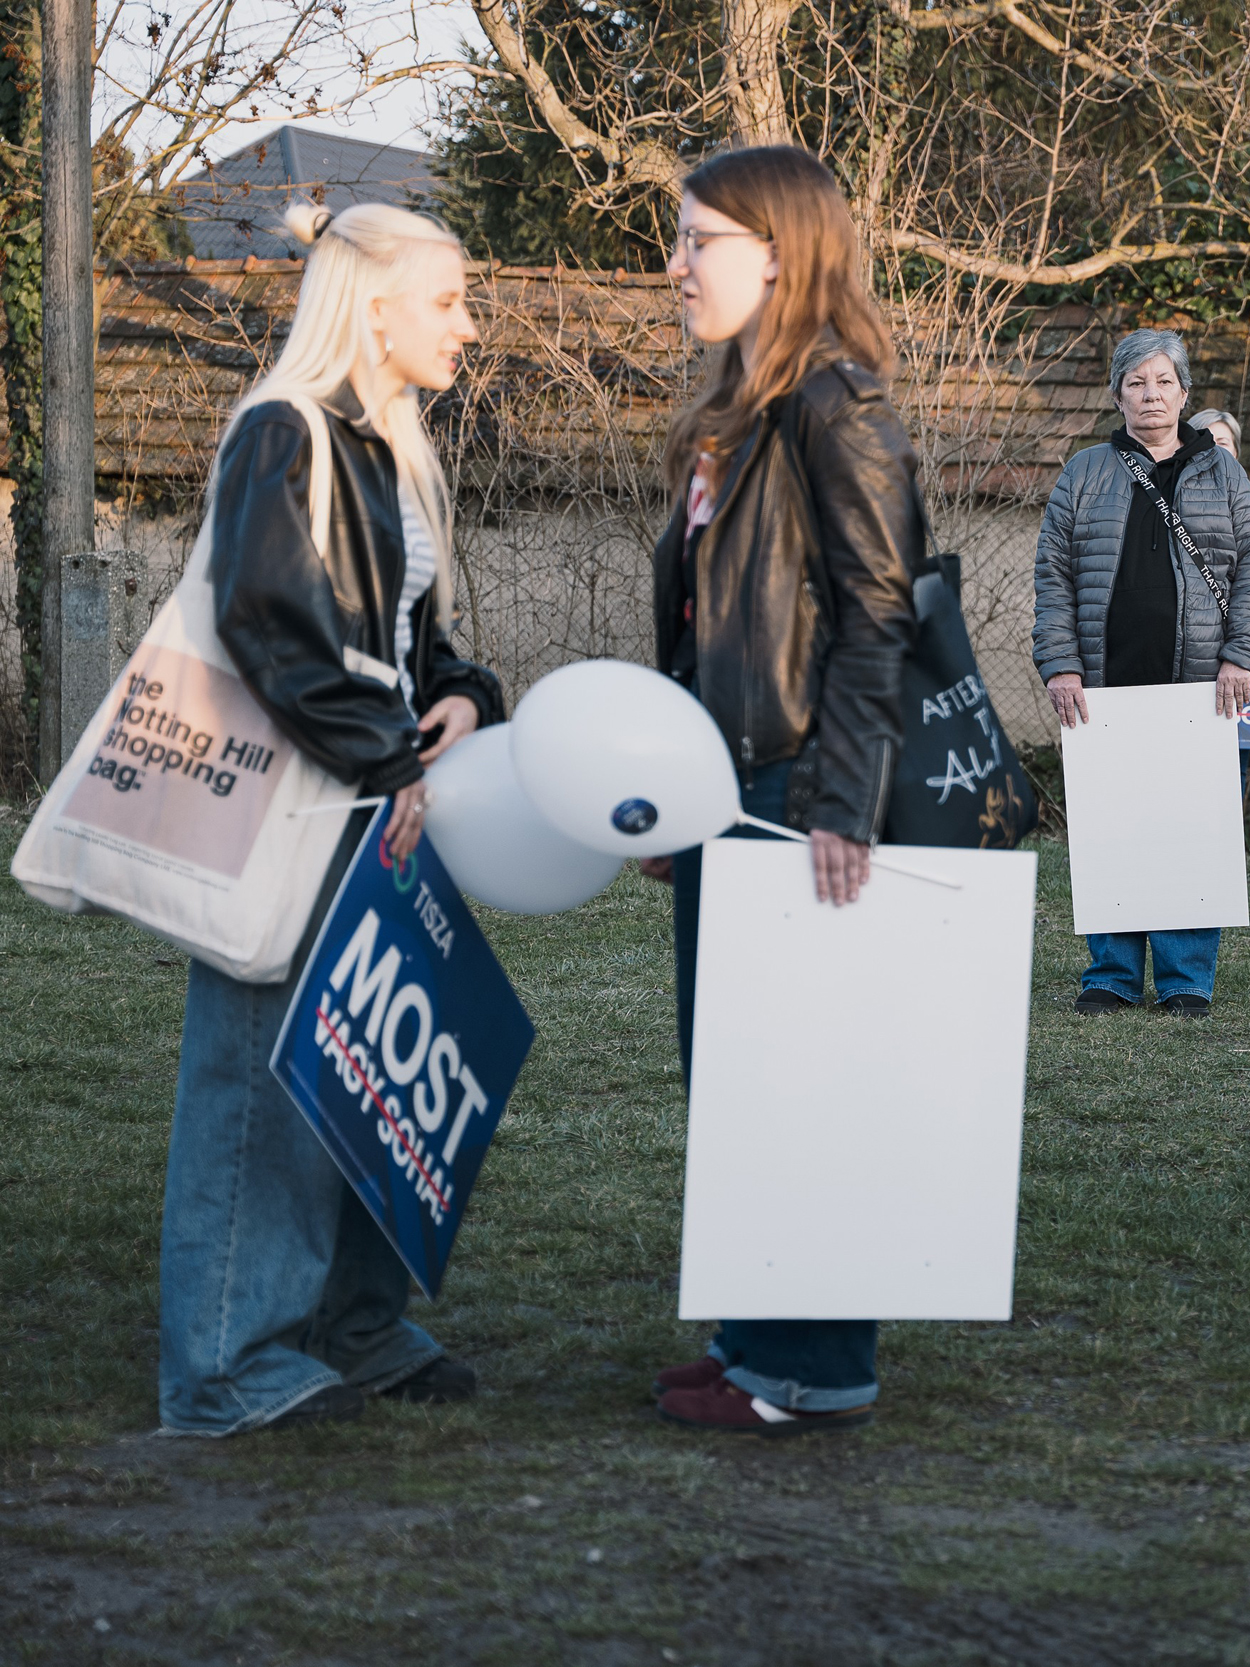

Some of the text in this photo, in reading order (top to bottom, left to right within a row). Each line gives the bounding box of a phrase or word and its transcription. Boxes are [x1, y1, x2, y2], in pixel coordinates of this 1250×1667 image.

[1131, 464, 1155, 490] RIGHT
[1175, 525, 1200, 556] RIGHT
[1201, 564, 1222, 599] THAT'S
[128, 672, 164, 700] the
[922, 674, 986, 725] AFTER
[102, 725, 238, 797] shopping
[220, 736, 274, 774] Hill
[412, 881, 456, 960] TISZA
[328, 906, 489, 1166] MOST
[313, 990, 455, 1226] VAGY SOHA!
